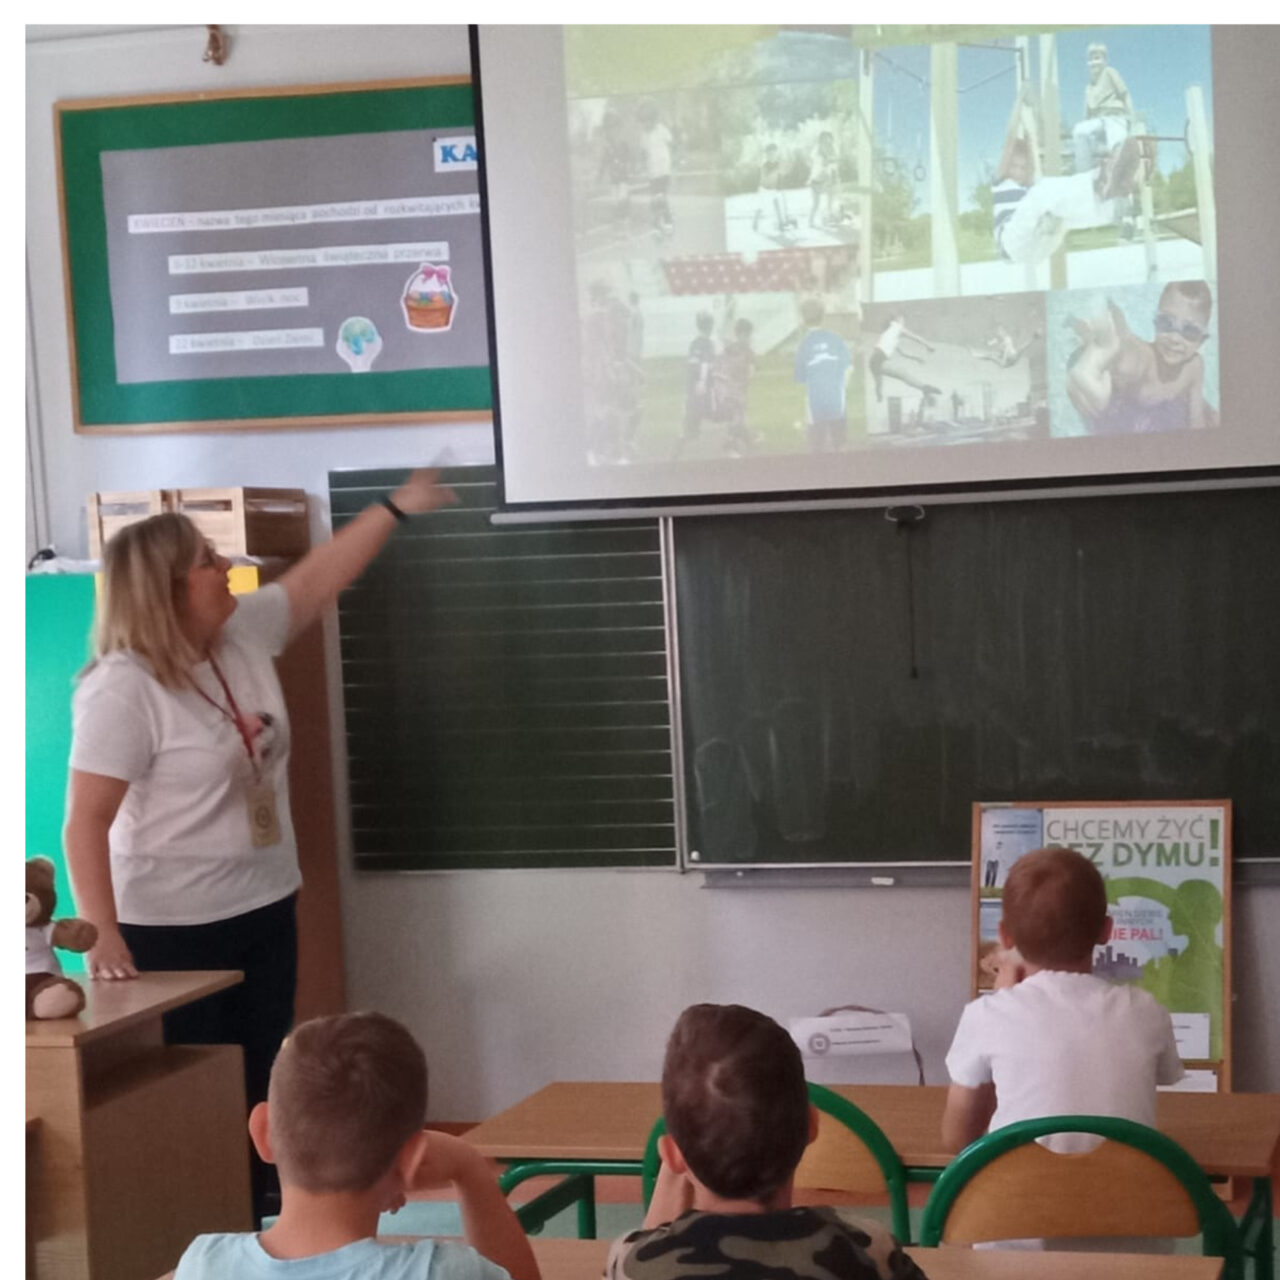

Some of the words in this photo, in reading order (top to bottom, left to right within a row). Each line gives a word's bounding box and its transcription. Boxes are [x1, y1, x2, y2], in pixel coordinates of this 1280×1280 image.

[440, 144, 478, 162] KA
[1047, 819, 1150, 840] CHCEMY
[1157, 815, 1204, 840] ŻYĆ
[1130, 928, 1163, 940] PAL!
